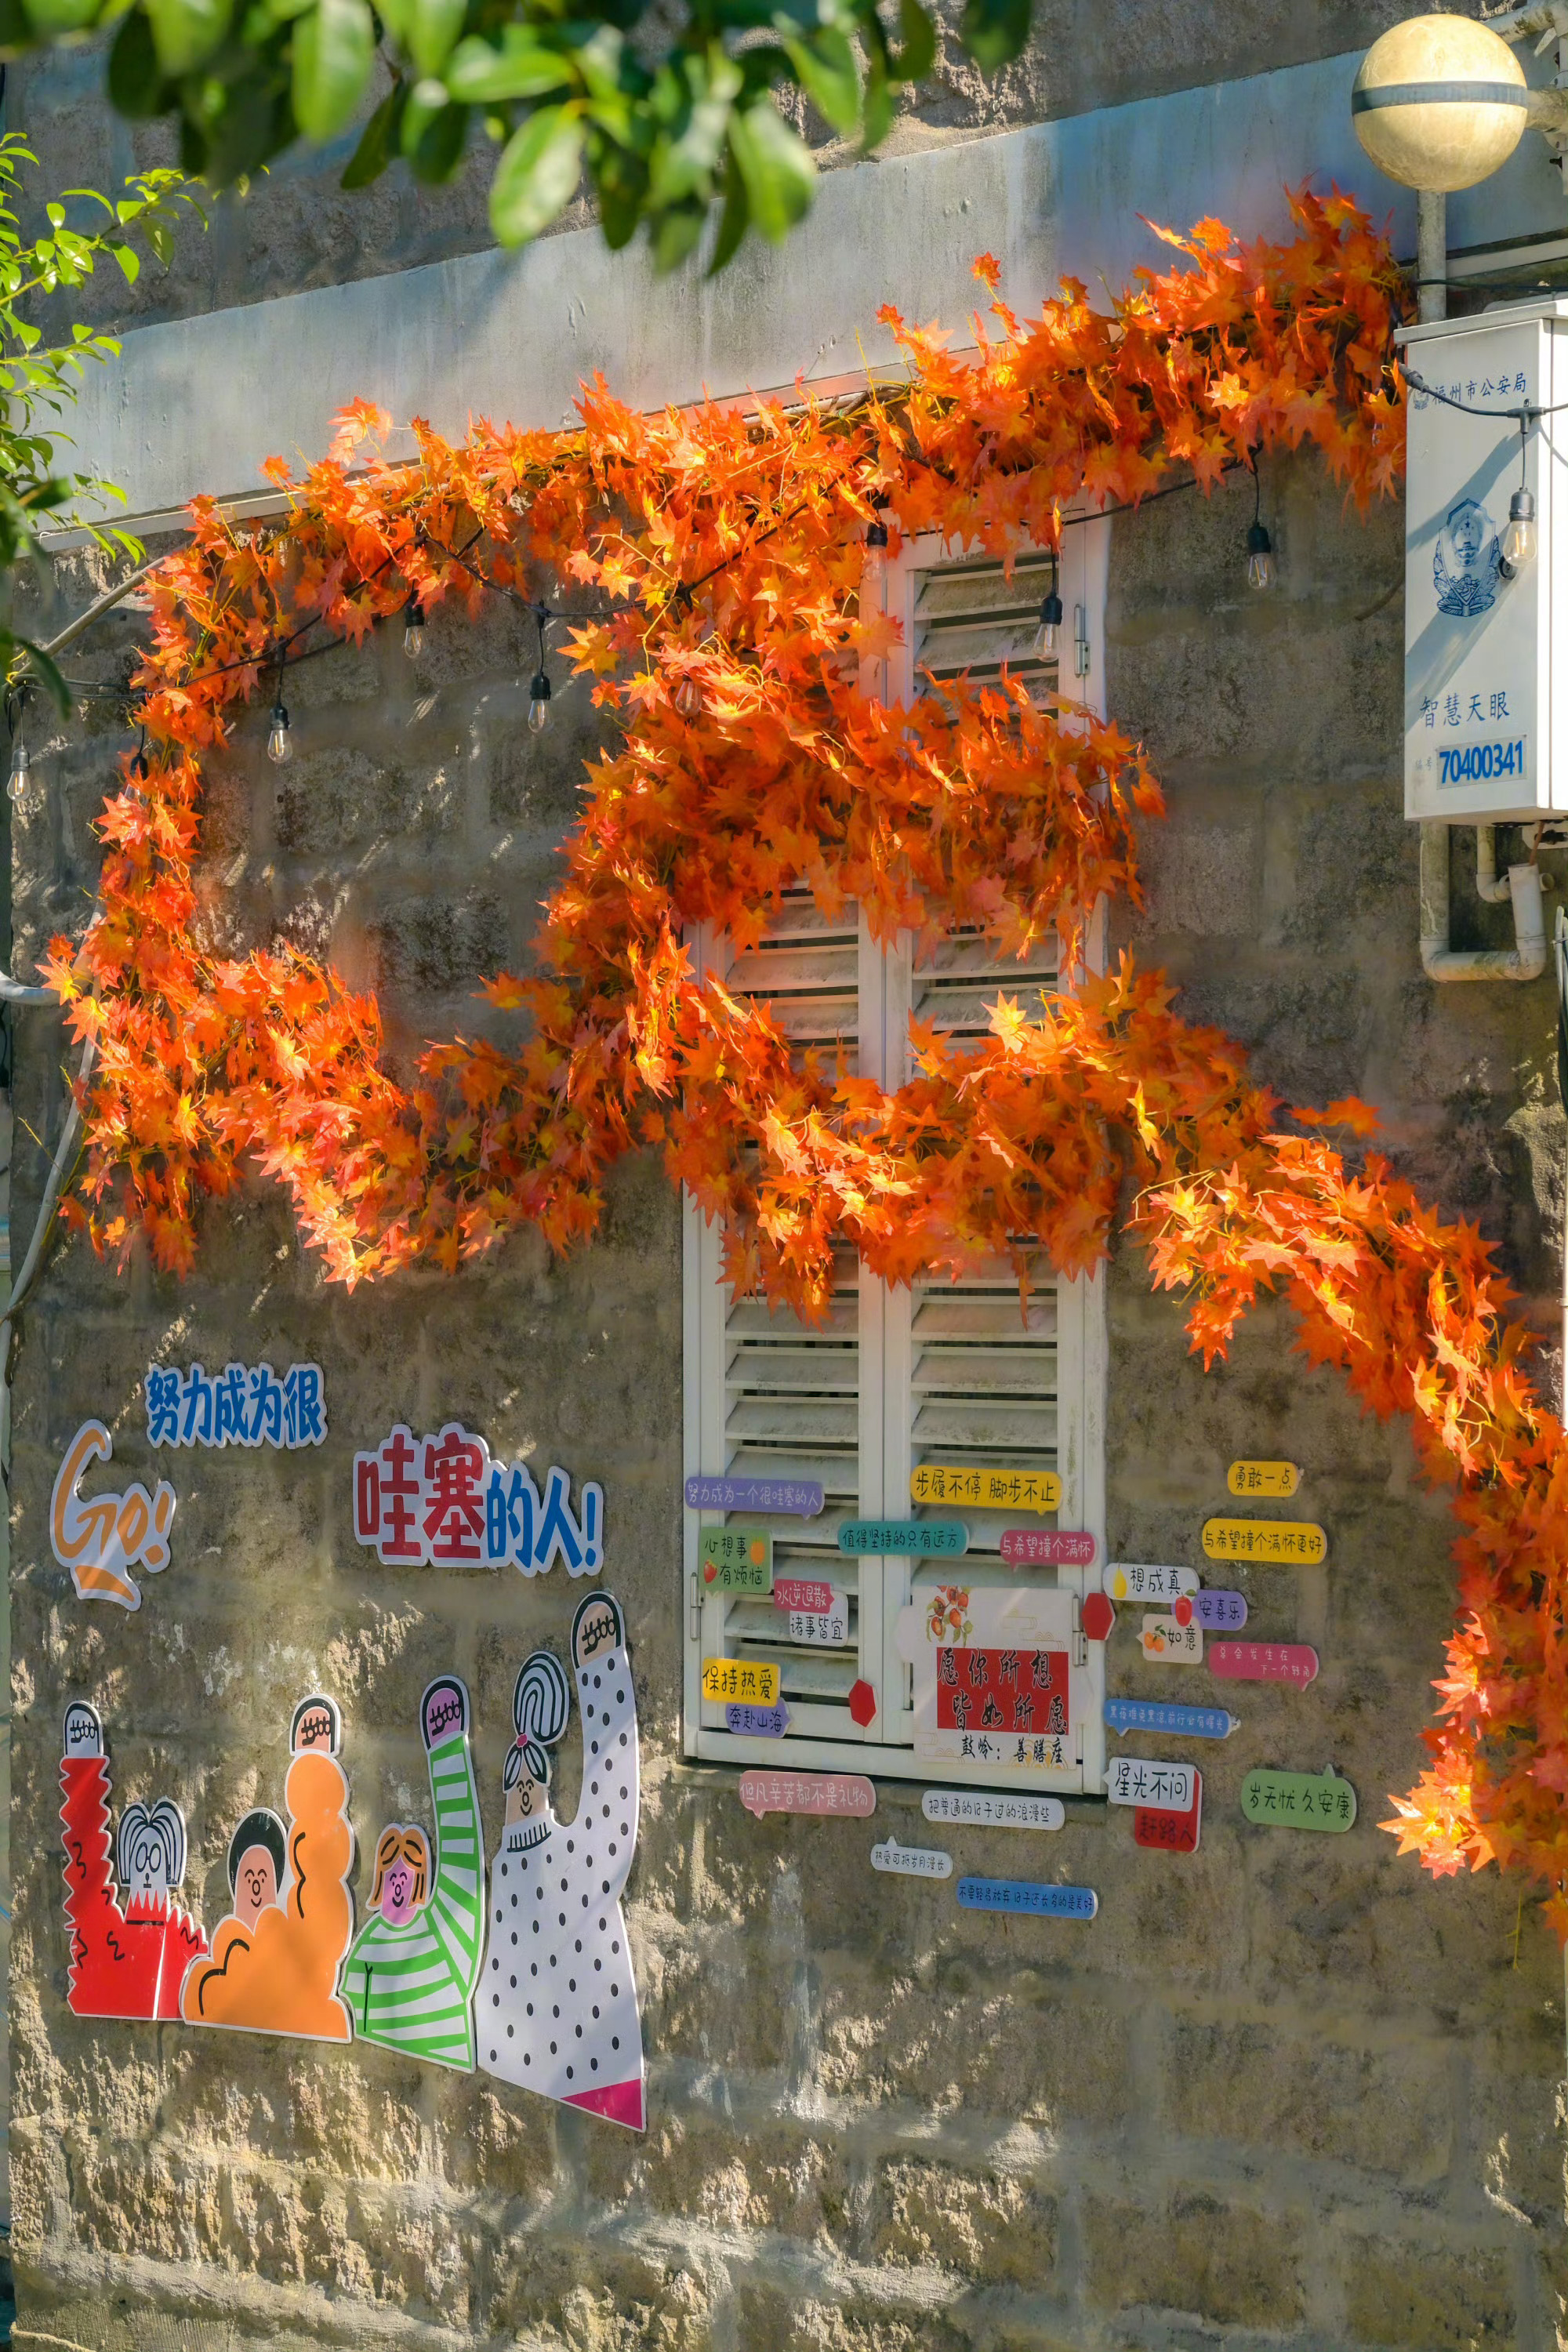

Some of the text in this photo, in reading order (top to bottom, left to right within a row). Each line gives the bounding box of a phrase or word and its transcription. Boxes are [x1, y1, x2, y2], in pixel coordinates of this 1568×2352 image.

[1432, 372, 1526, 405] 福州市公安局
[1420, 691, 1510, 729] 智慧天眼
[1439, 739, 1524, 785] 70400341
[147, 1368, 322, 1444] 努力成为很
[916, 1469, 1054, 1503] 步履不停 脚步不止
[1236, 1466, 1291, 1490] 勇敢一点
[687, 1483, 818, 1507] 努力成为一个很哇塞的人
[705, 1536, 747, 1559] 心想事
[843, 1530, 959, 1548] 值得坚持的只有远方
[1002, 1535, 1091, 1558] 与希望撞个满怀
[1203, 1530, 1322, 1555] 与希望撞个满怀更好
[720, 1566, 763, 1585] 有烦恼
[1131, 1568, 1181, 1595] 想成真
[777, 1584, 828, 1608] 水逆退散
[1199, 1598, 1240, 1621] 安喜乐
[790, 1617, 843, 1640] 诸事皆宜
[1167, 1624, 1196, 1650] 如意
[702, 1665, 773, 1700] 保持热爱
[937, 1647, 1053, 1693] 愿你所想
[1261, 1664, 1310, 1678] 下一个转角
[730, 1705, 782, 1730] 奔赴山海
[953, 1690, 1068, 1736] 皆如所愿
[739, 1777, 868, 1809] 但凡辛苦都不是礼物
[1115, 1762, 1188, 1802] 星光不问
[928, 1798, 1050, 1823] 把普通的日子过的浪漫些
[1138, 1813, 1194, 1844] 赶路人
[875, 1850, 944, 1871] 热爱可抵岁月漫长
